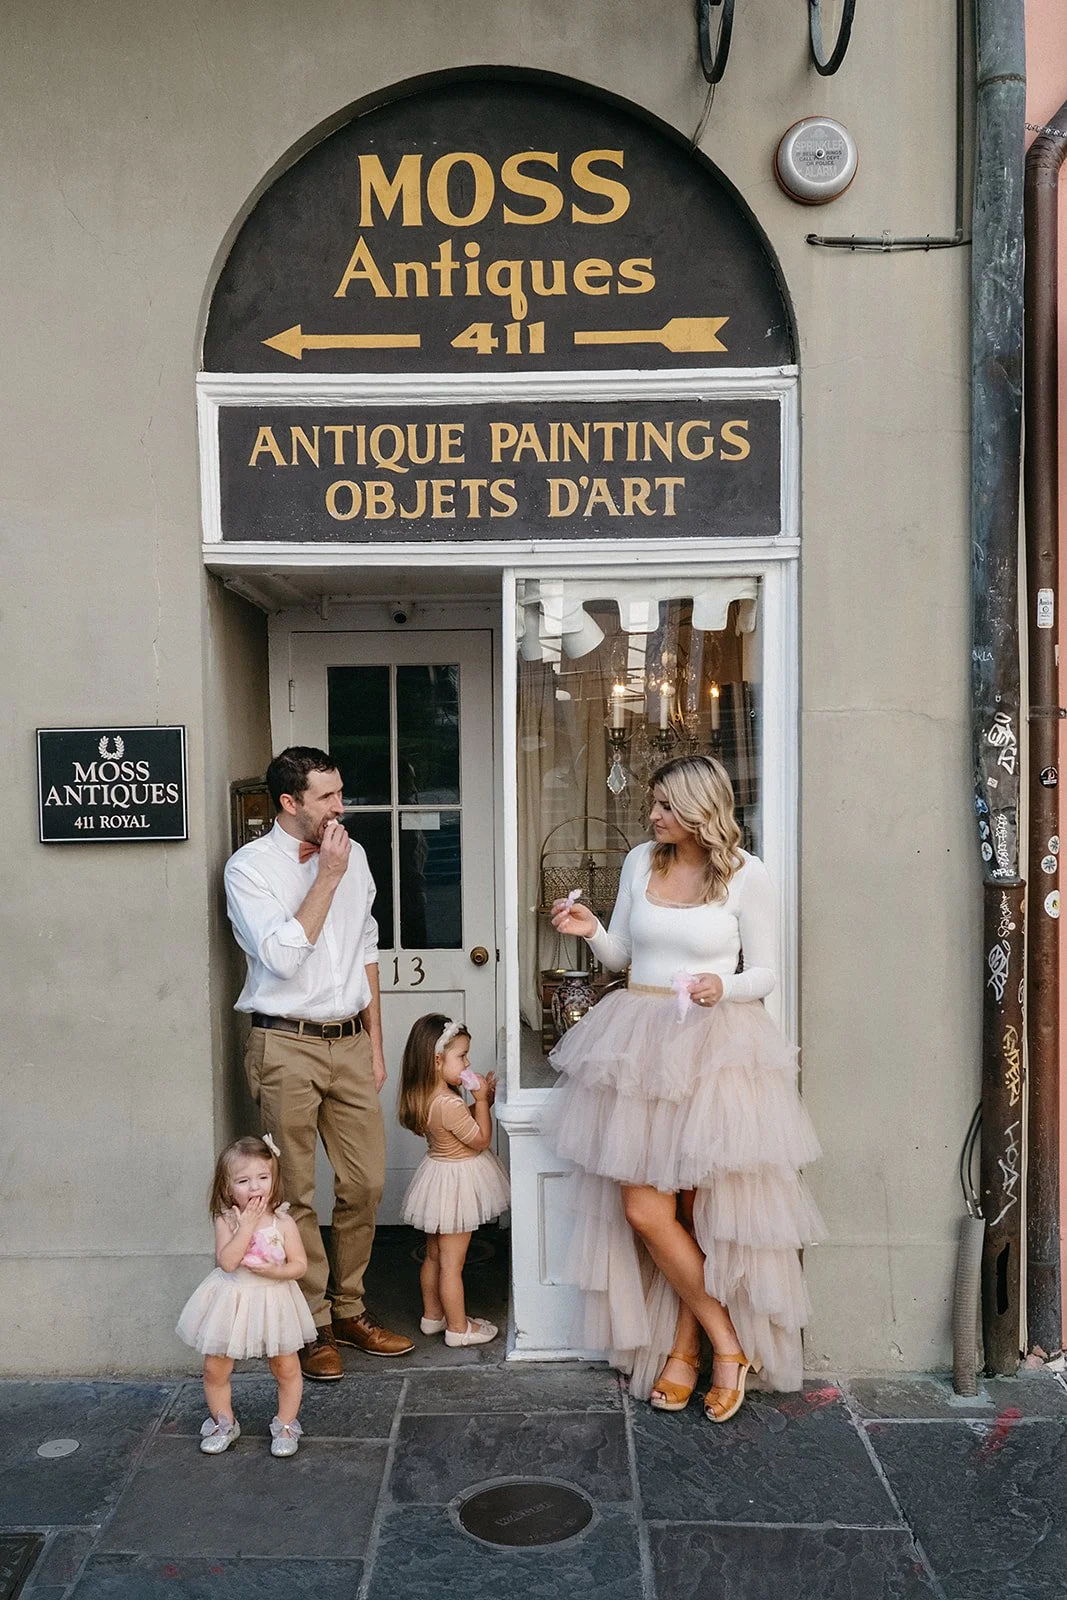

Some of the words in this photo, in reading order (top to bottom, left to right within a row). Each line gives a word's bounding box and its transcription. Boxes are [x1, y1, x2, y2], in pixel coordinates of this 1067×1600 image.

[794, 139, 845, 153] SPRINKLER
[804, 165, 837, 178] ALARM
[358, 150, 630, 226] MOSS
[334, 236, 655, 320] Antiques
[451, 321, 545, 354] 411
[248, 424, 465, 473] ANTIQUE
[489, 420, 750, 463] PAINTINGS
[326, 479, 517, 520] OBJETS
[547, 476, 685, 517] D'ART
[72, 761, 149, 783] MOSS
[45, 783, 178, 808] ANTIQUES
[74, 816, 94, 829] 411
[100, 815, 150, 828] ROYAL
